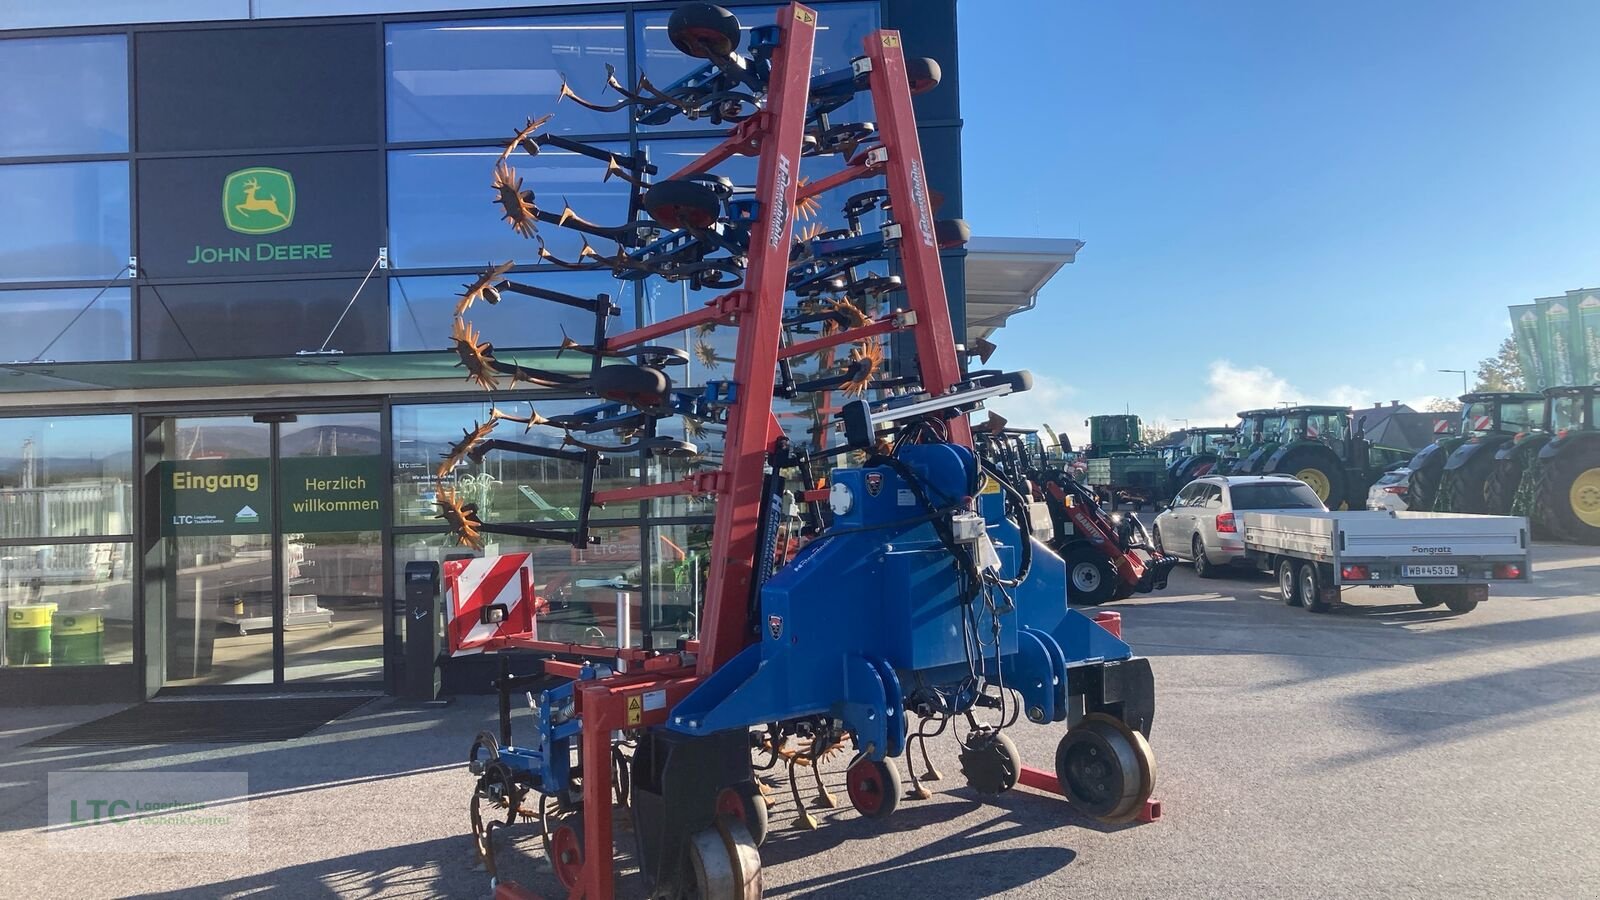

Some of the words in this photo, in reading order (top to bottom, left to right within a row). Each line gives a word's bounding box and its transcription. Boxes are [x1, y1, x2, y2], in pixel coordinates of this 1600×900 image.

[187, 245, 250, 264] JOHN
[256, 243, 333, 261] DEERE
[172, 471, 259, 493] Eingang
[305, 476, 366, 491] Herzlich
[293, 498, 379, 513] willkommen
[173, 515, 193, 525] LTC
[1411, 546, 1452, 554] Pongratz
